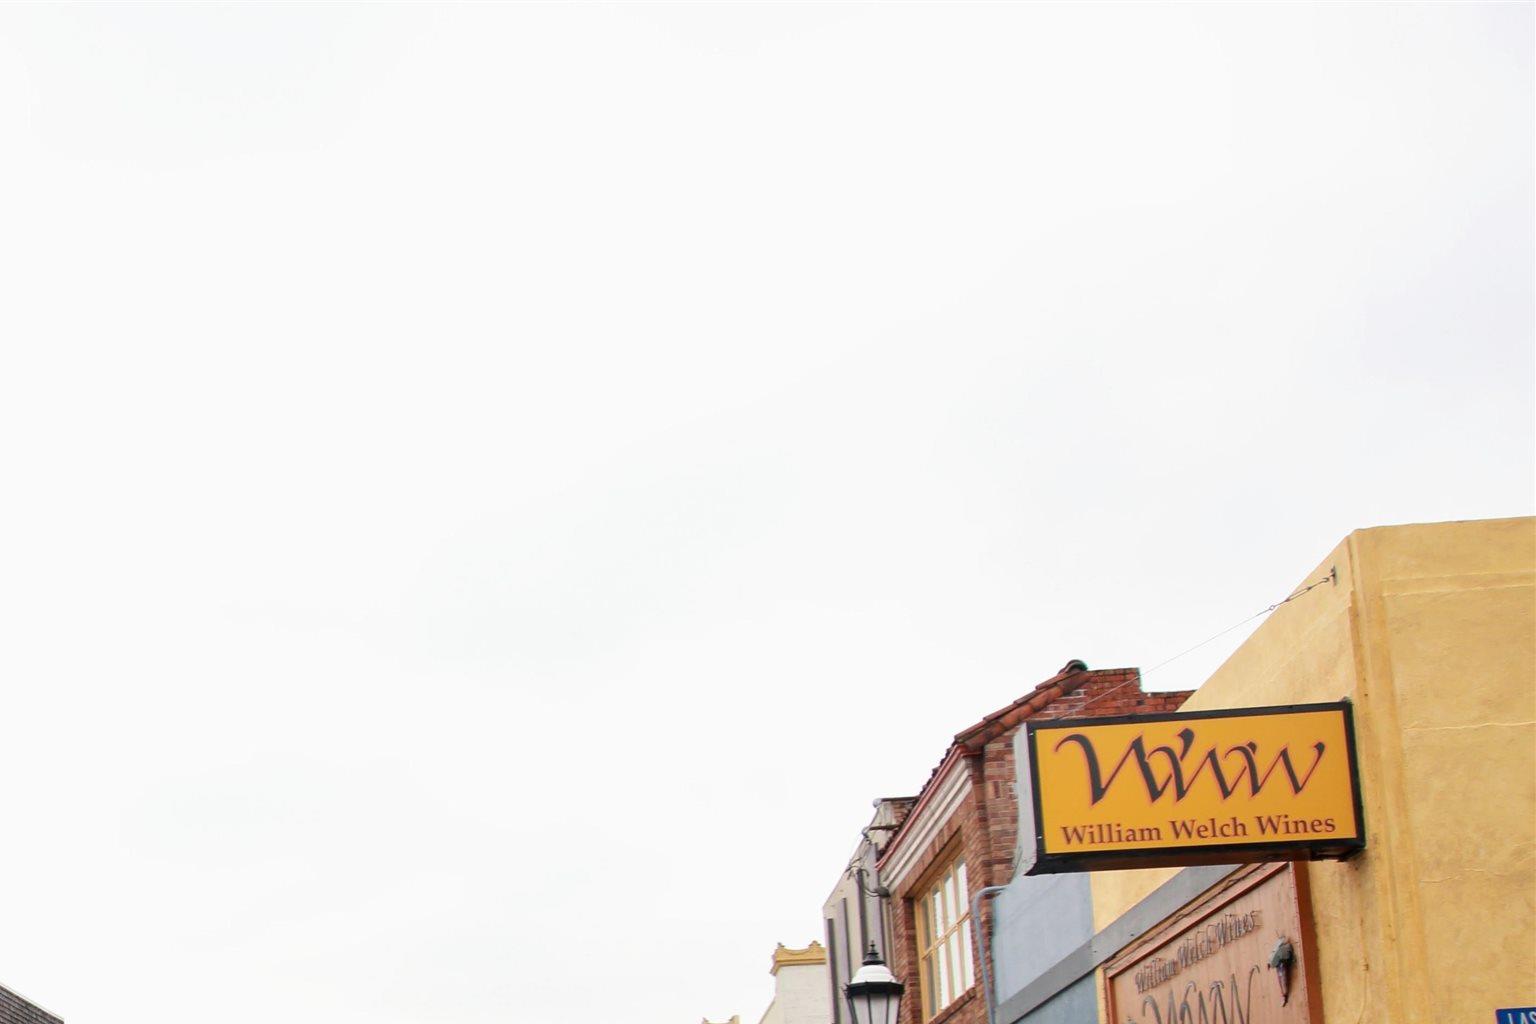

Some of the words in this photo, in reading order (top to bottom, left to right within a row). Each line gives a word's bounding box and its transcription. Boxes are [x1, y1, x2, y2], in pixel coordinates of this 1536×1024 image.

[1060, 824, 1162, 846] William
[1169, 817, 1248, 840] Welch
[1255, 815, 1337, 836] Wines
[1135, 958, 1179, 994] William
[1178, 940, 1213, 968] Welch
[1215, 913, 1257, 947] Wines
